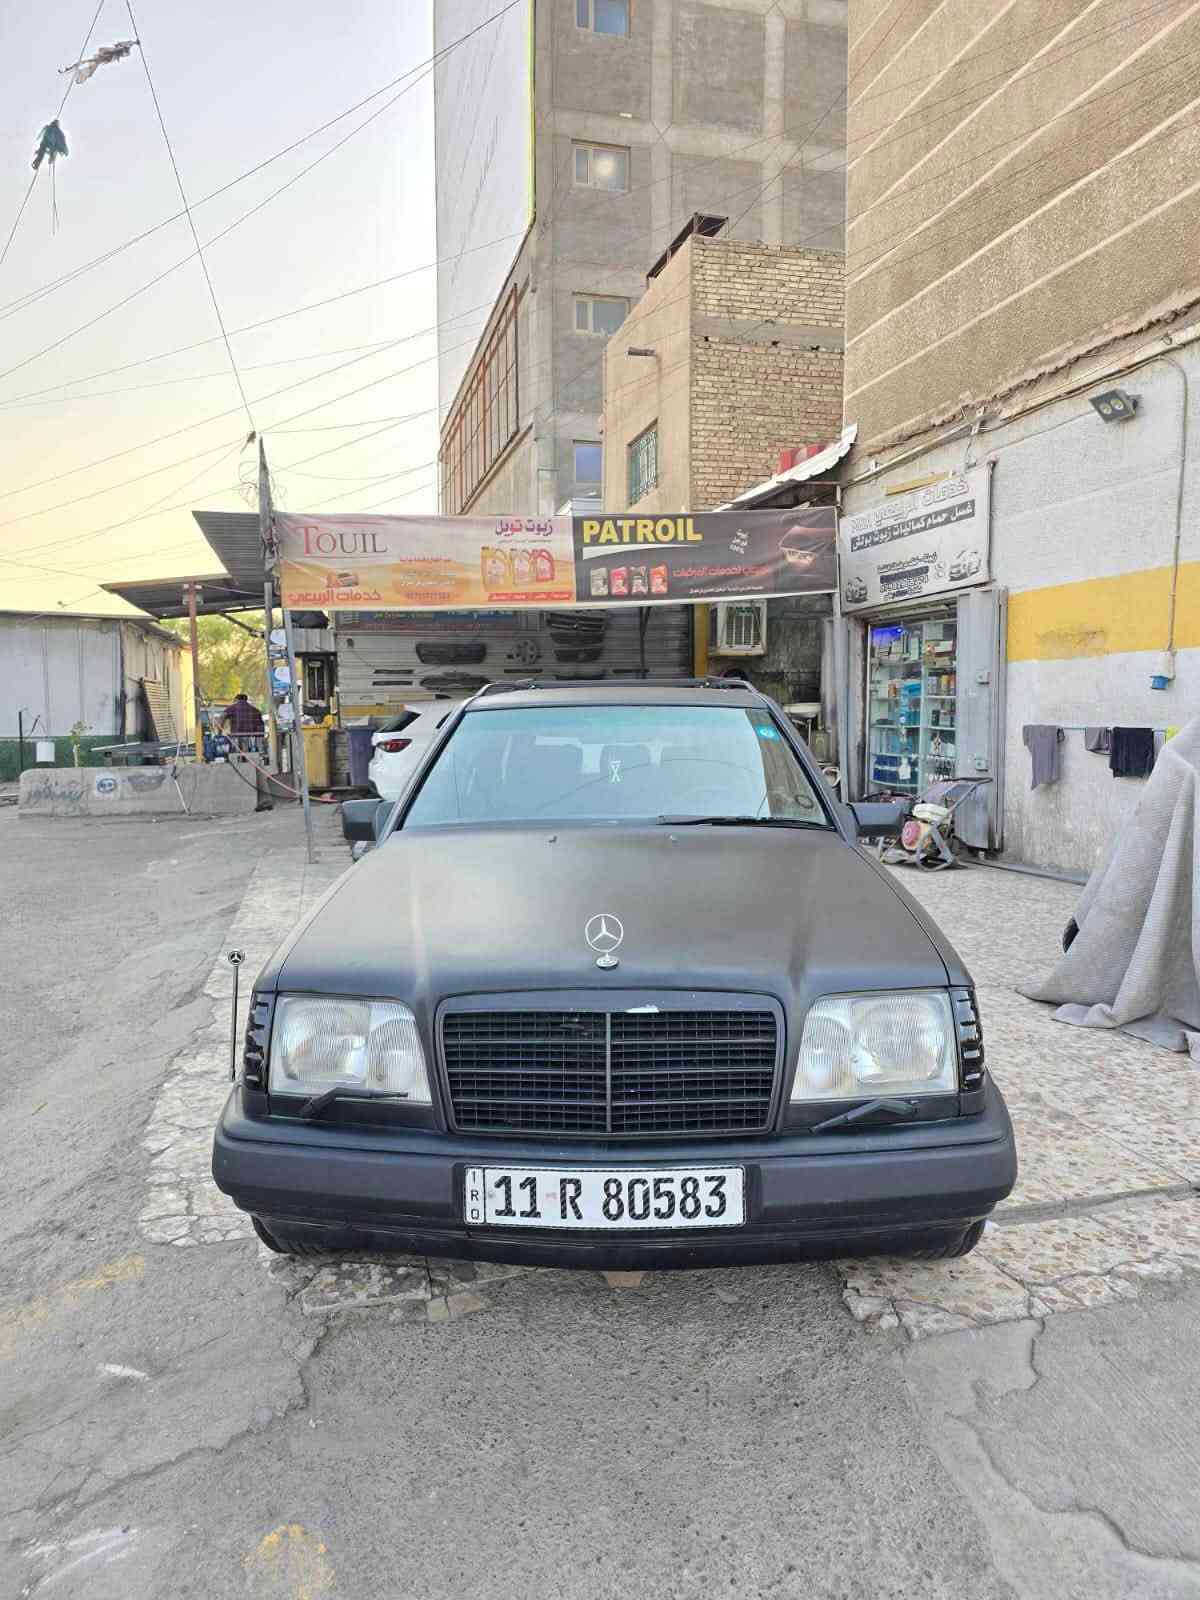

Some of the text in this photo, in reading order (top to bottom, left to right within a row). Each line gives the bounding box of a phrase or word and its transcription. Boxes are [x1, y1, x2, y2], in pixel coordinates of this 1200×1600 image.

[299, 526, 389, 555] TOUIL
[526, 519, 553, 537] زيوت
[583, 518, 704, 544] PATROIL
[335, 590, 383, 601] خدمات
[494, 1175, 727, 1222] 11 R 80583
